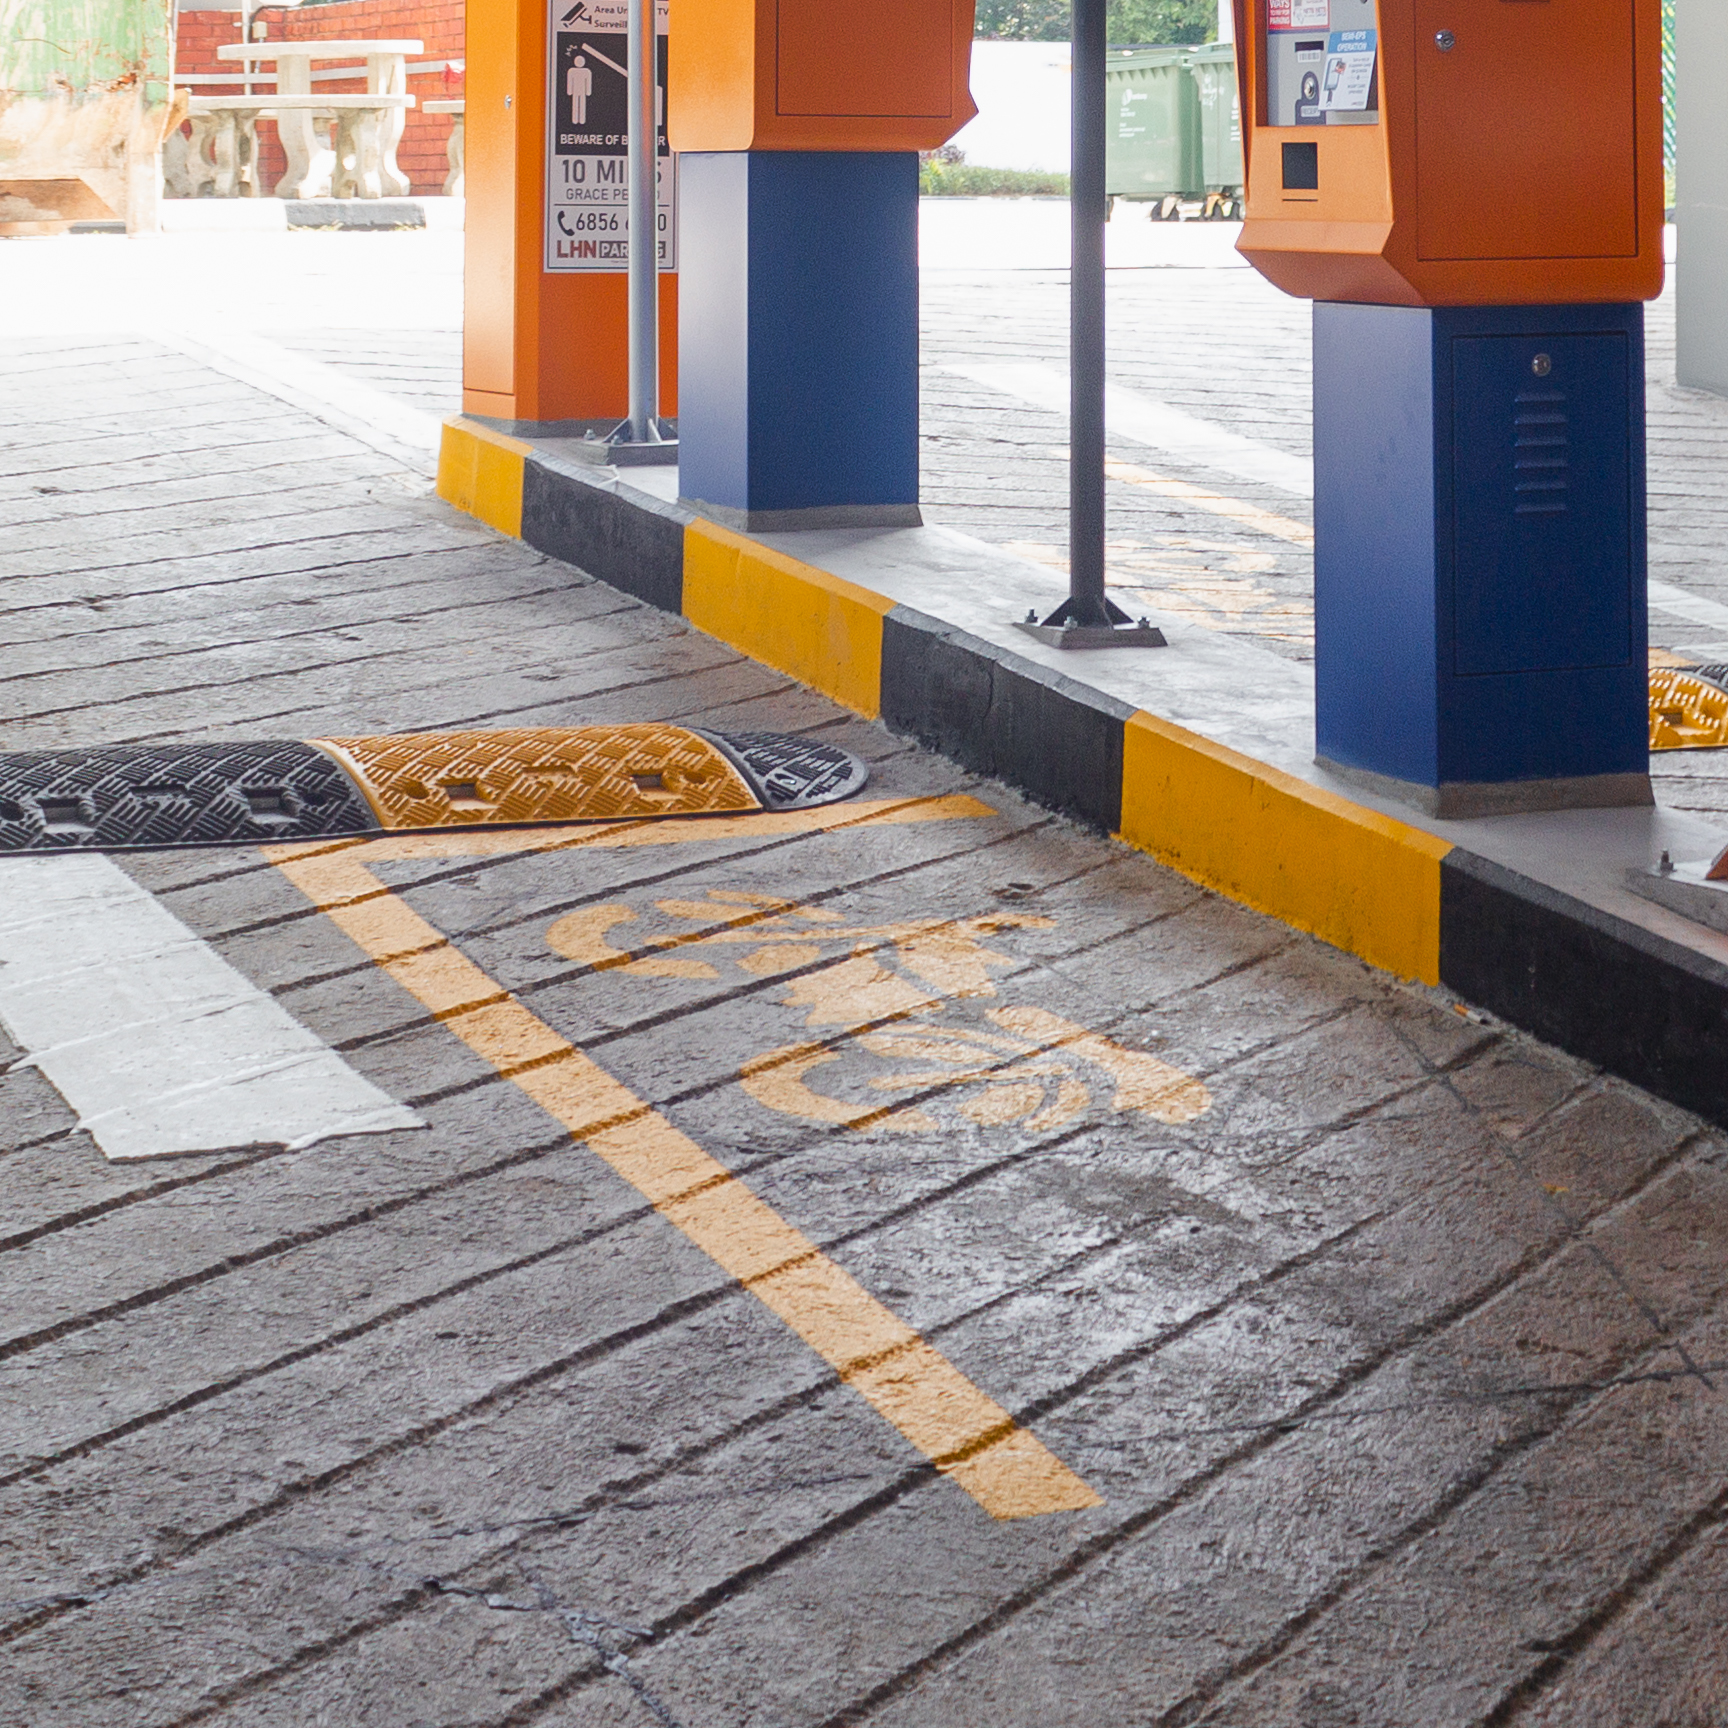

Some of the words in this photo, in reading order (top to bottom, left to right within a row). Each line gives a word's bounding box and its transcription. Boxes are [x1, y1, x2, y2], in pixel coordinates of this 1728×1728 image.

[594, 5, 615, 14] Area
[560, 134, 603, 146] BEWARE
[605, 134, 620, 146] OF
[562, 159, 586, 184] 10
[566, 188, 609, 201] GRACE
[575, 213, 619, 232] 6856
[557, 240, 597, 259] LHN
